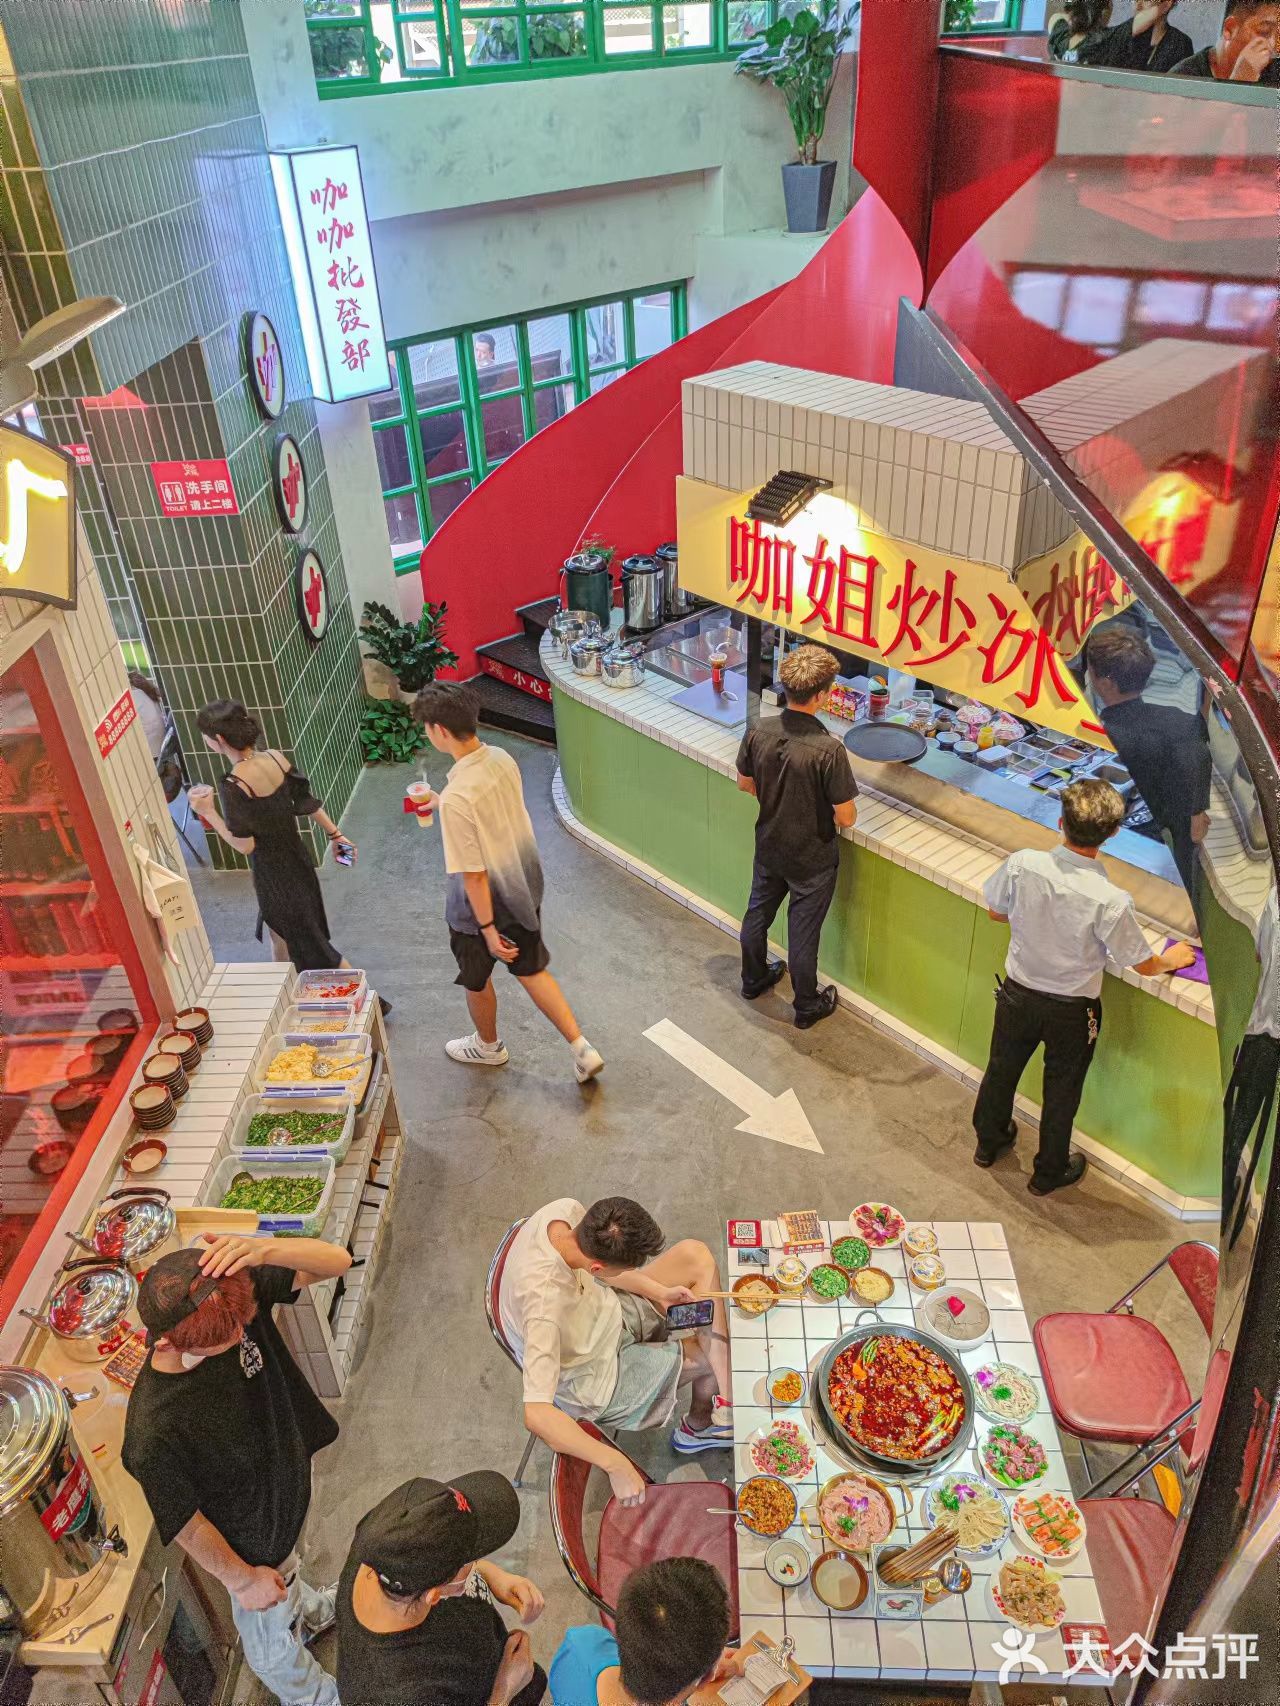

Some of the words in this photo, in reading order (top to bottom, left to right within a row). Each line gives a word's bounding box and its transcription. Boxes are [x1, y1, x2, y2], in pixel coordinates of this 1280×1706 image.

[310, 177, 370, 372] 咖咖批發部
[185, 480, 229, 495] 洗手间
[190, 498, 233, 511] 请上二楼
[513, 671, 553, 700] 小心
